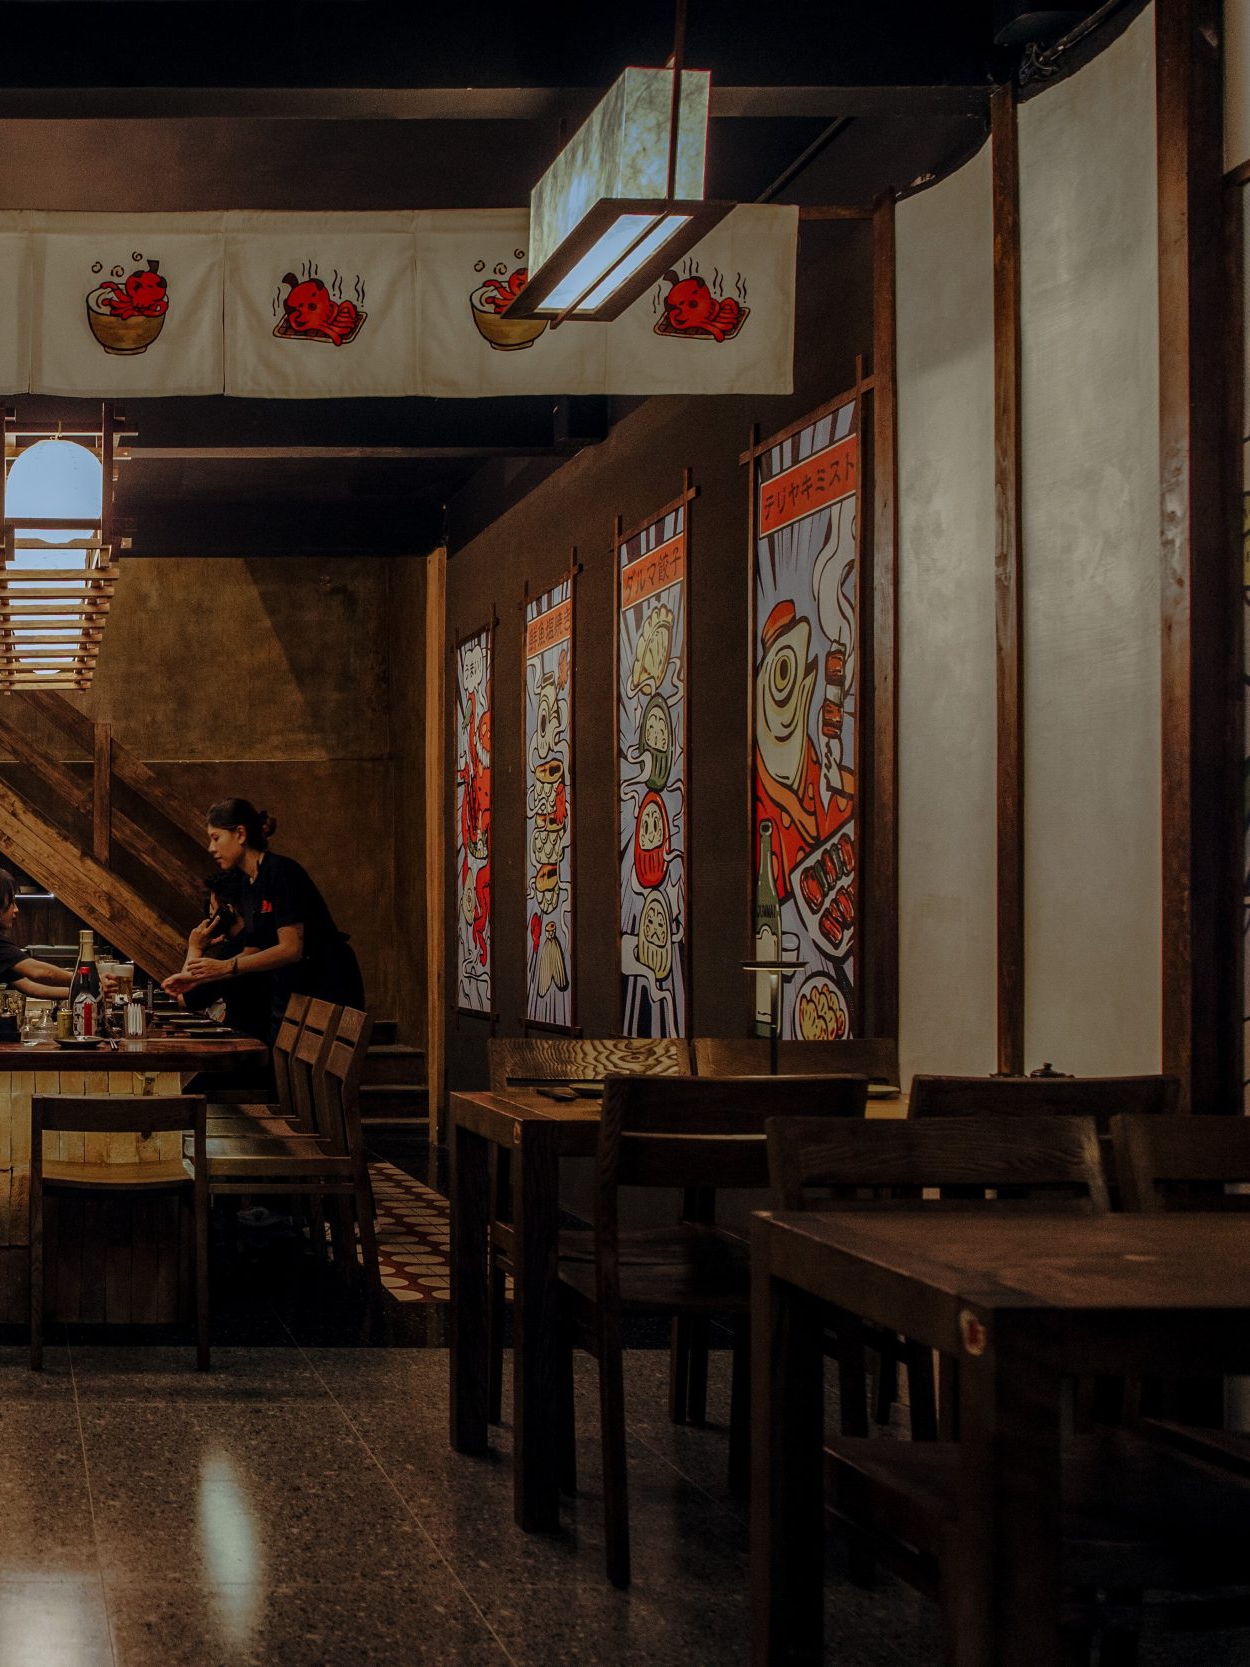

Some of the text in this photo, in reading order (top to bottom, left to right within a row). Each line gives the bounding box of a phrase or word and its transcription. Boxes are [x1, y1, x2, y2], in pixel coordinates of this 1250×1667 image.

[625, 547, 681, 602] ダルマ餃子
